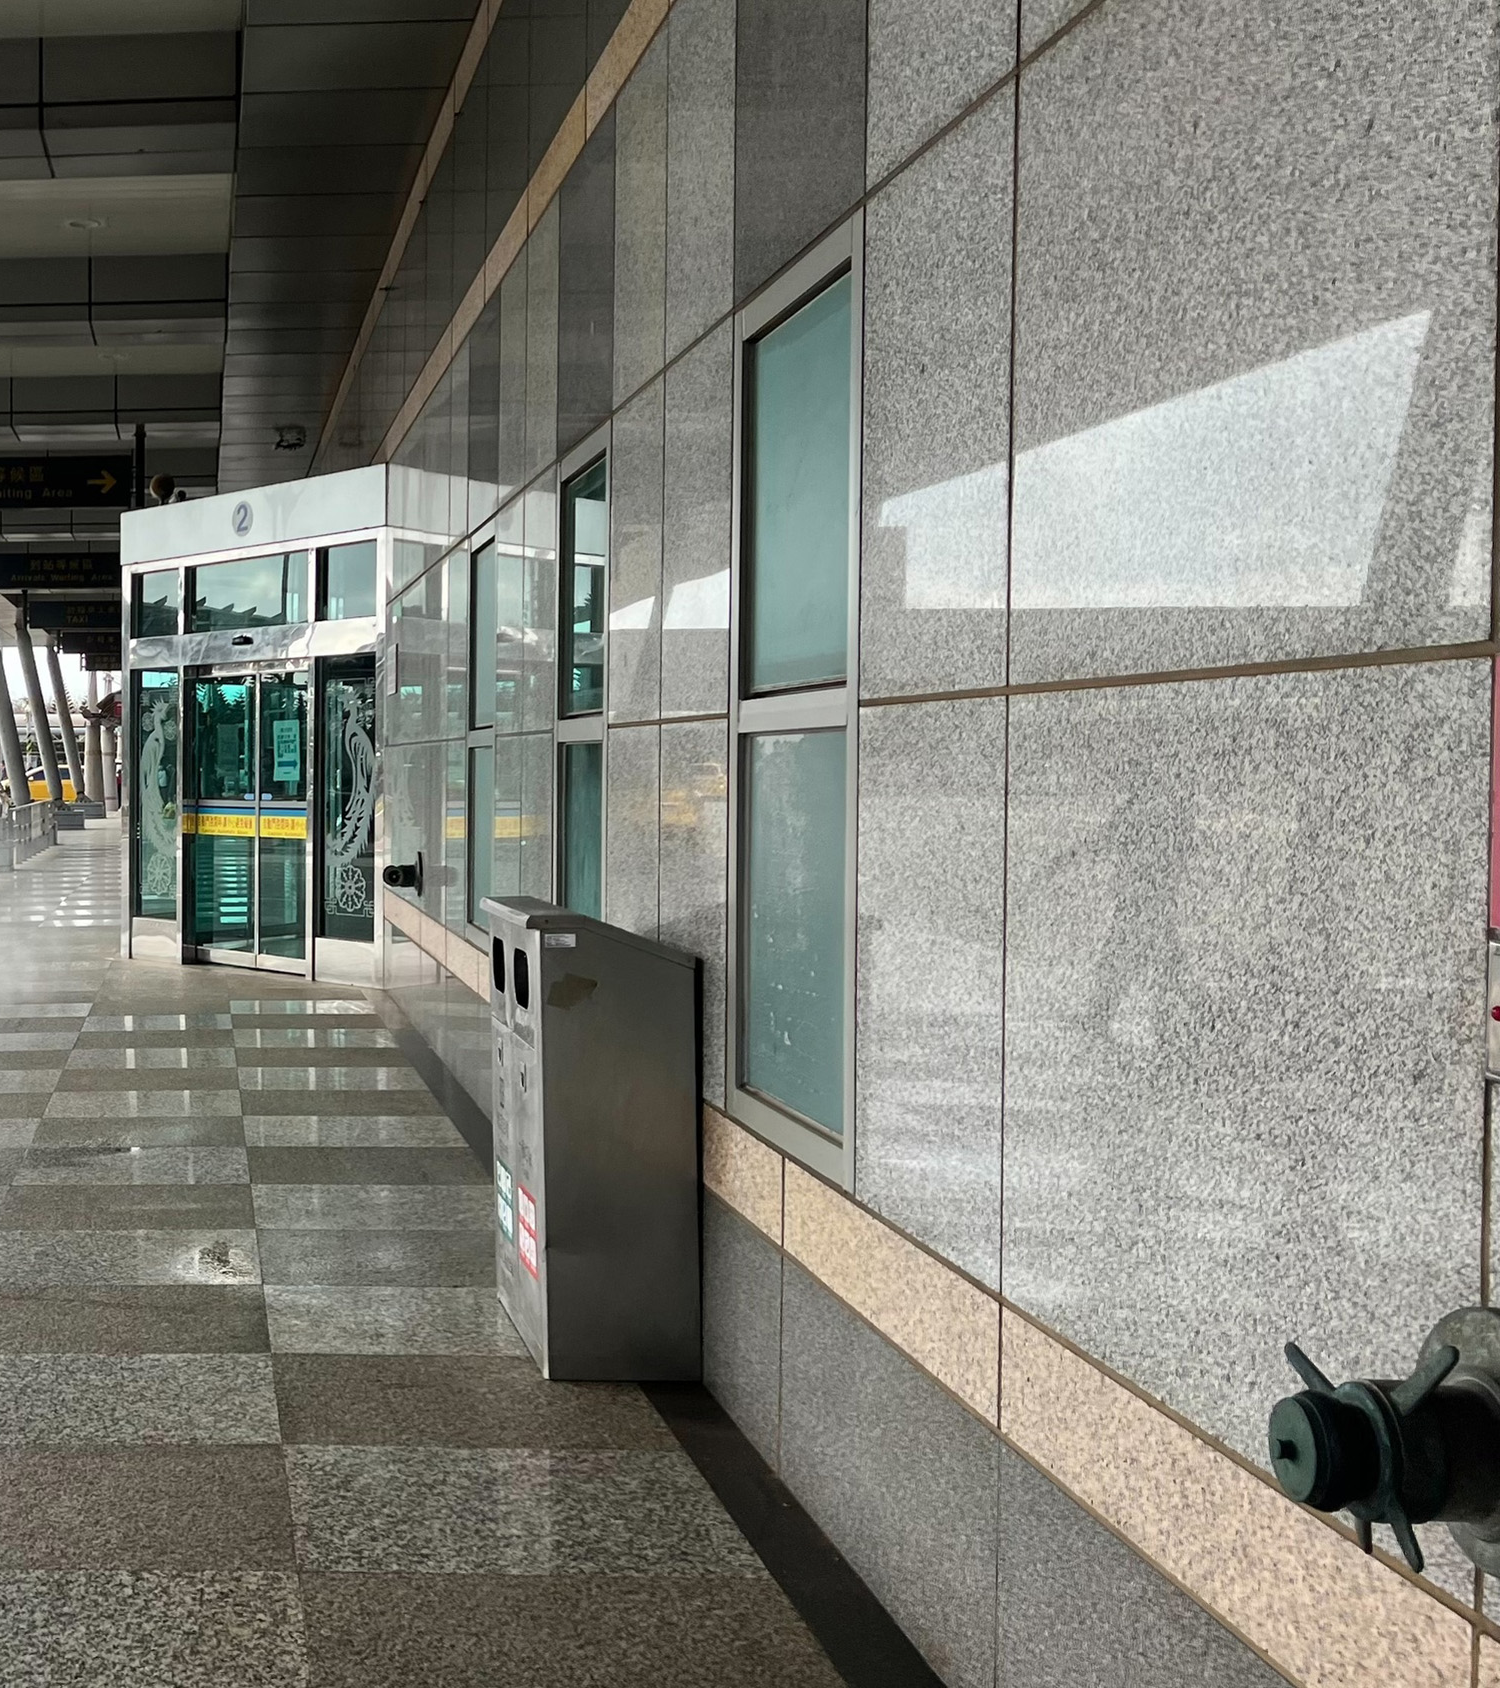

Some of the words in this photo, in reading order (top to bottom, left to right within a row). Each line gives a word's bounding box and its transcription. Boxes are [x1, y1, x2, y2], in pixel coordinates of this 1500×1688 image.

[42, 487, 73, 498] Area
[236, 503, 249, 533] 2
[66, 615, 88, 624] TAXI
